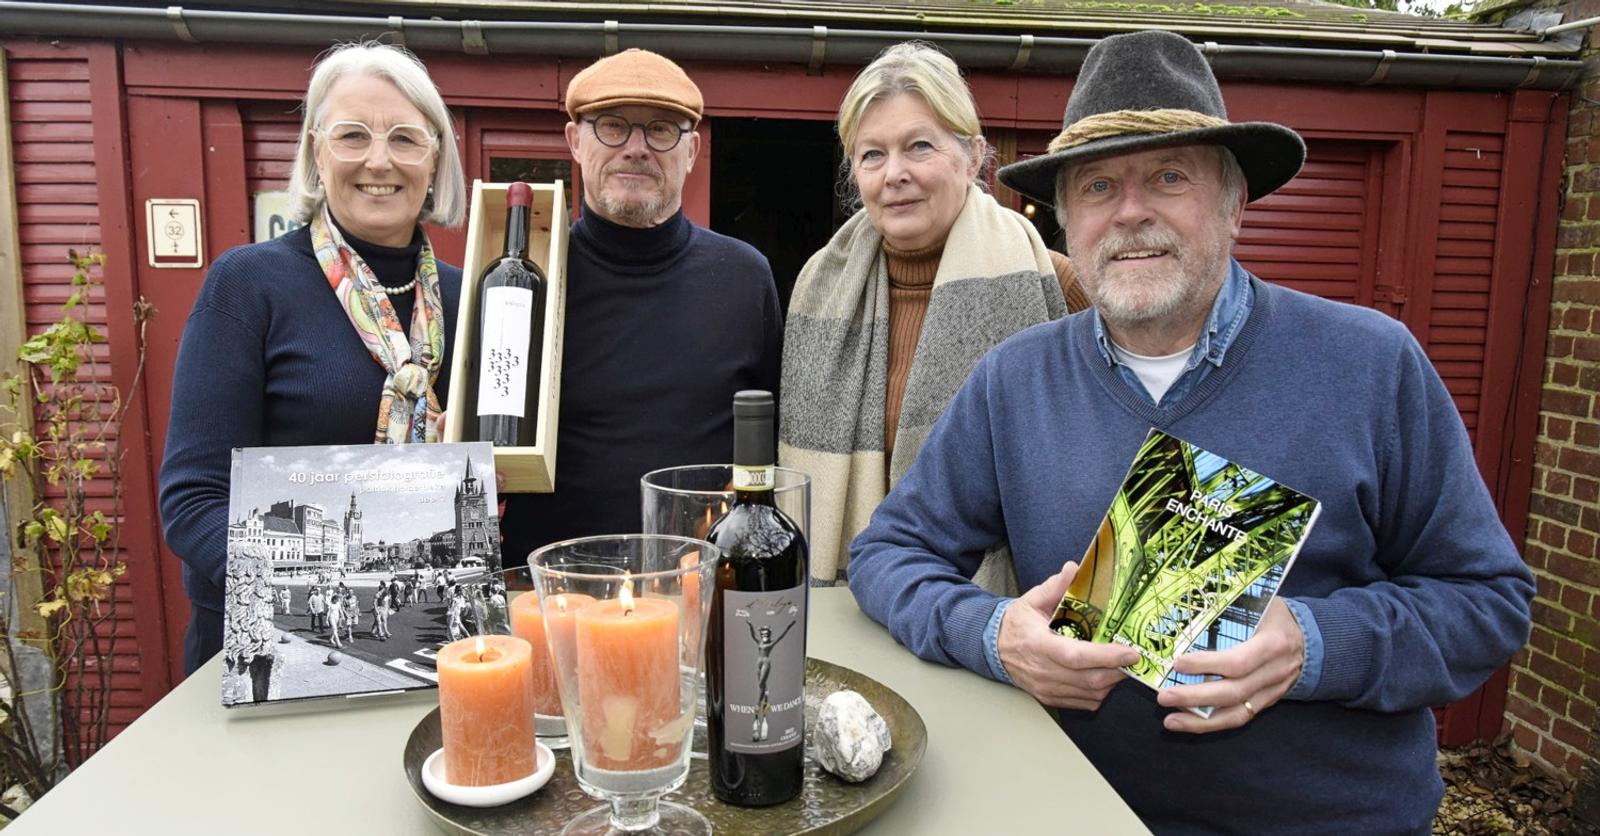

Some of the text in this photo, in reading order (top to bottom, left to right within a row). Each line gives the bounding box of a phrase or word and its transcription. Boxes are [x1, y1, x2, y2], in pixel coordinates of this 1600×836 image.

[168, 225, 182, 236] 32
[288, 472, 306, 482] 40
[310, 471, 339, 485] jaar
[1190, 489, 1234, 518] PARIS
[1166, 498, 1249, 543] ENCHANTE
[729, 703, 754, 714] WHEN
